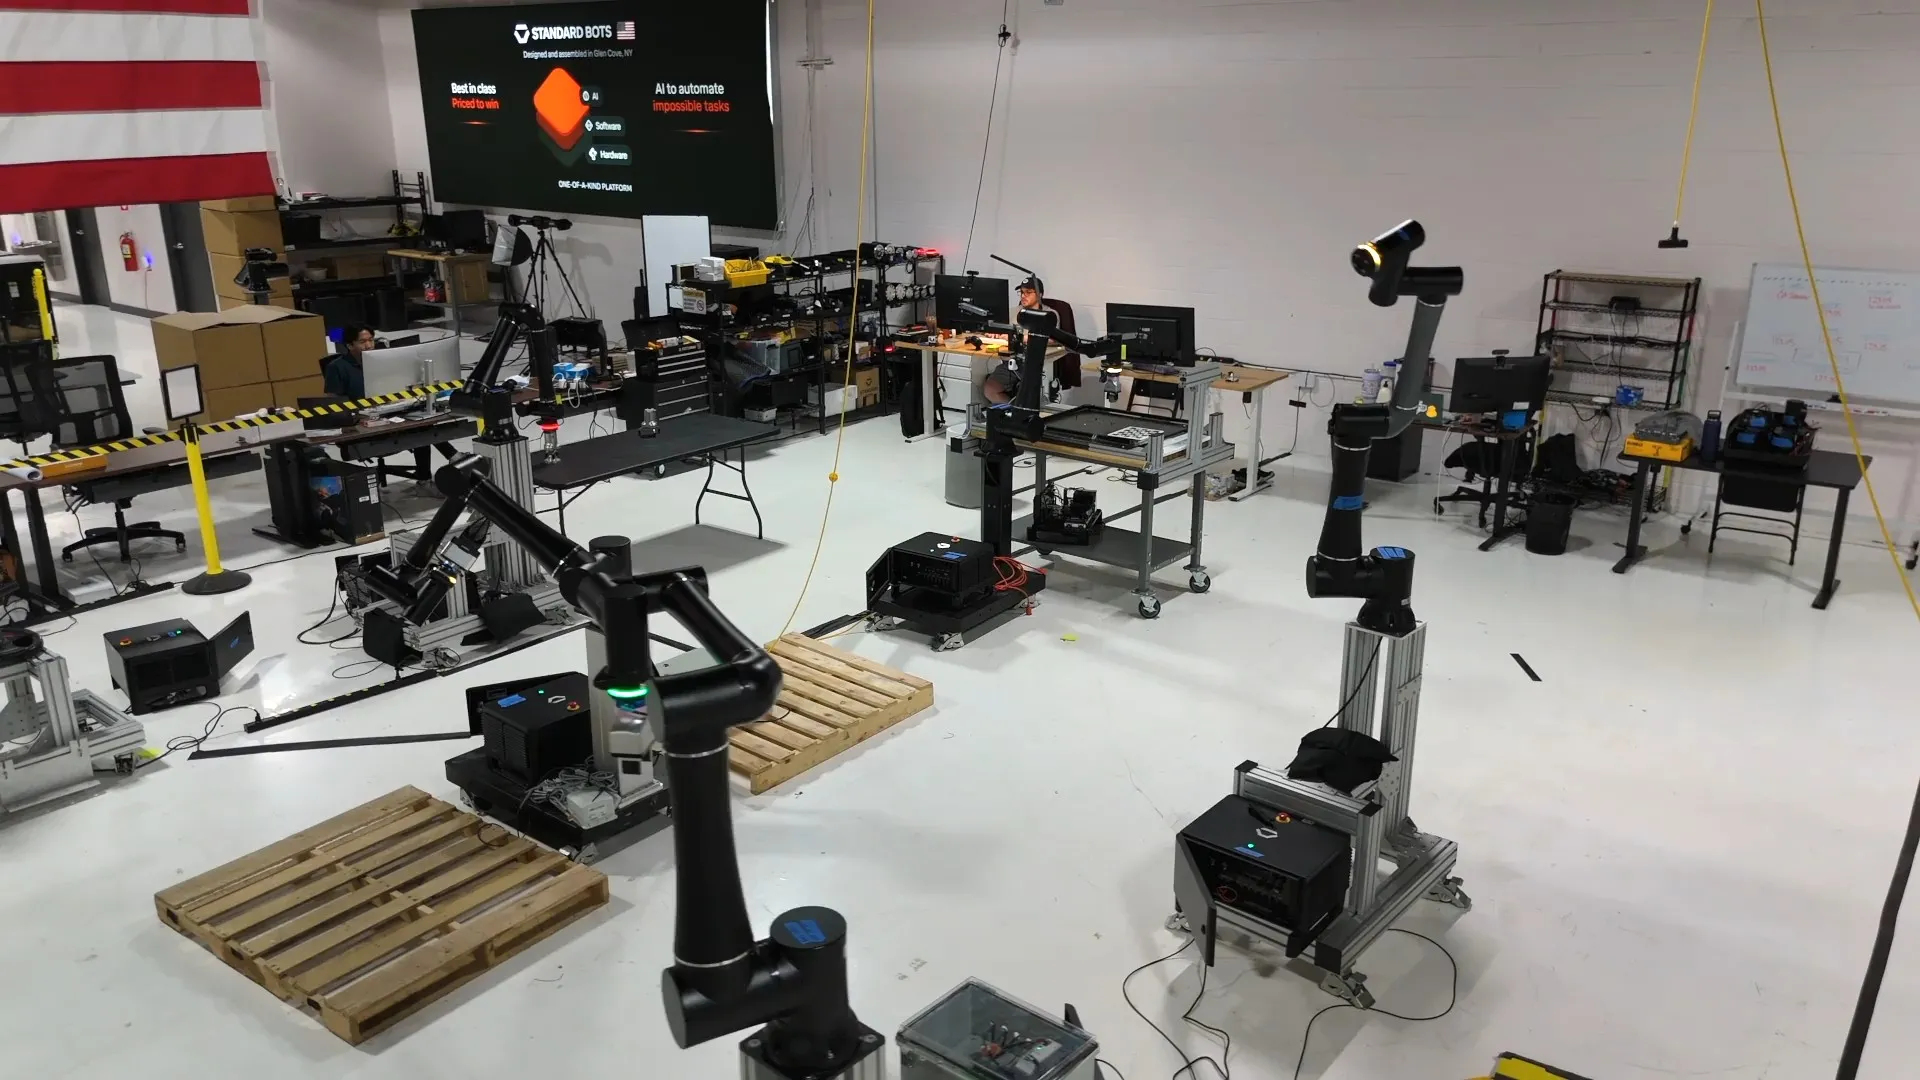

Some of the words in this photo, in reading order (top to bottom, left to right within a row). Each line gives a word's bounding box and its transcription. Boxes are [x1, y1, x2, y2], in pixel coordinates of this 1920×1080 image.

[531, 26, 584, 40] STANDARD
[585, 25, 612, 39] BOTS
[523, 50, 548, 60] Designed
[548, 50, 558, 58] and
[558, 50, 587, 58] assembled
[594, 49, 607, 57] Glen
[607, 49, 624, 58] Cove,
[624, 49, 633, 57] NY
[451, 82, 469, 94] Best
[468, 82, 477, 94] in
[477, 82, 497, 94] class
[655, 82, 665, 94] AI
[666, 82, 677, 94] to
[678, 82, 725, 95] automate
[592, 92, 599, 100] AI
[452, 98, 475, 109] Priced
[476, 99, 485, 109] to
[485, 99, 500, 109] win
[652, 100, 702, 114] impossible
[704, 100, 730, 112] tasks
[594, 121, 622, 131] Software
[600, 150, 628, 160] Hardware
[558, 180, 601, 191] ONE-OF-A-KIND
[601, 183, 633, 192] PLATFORM
